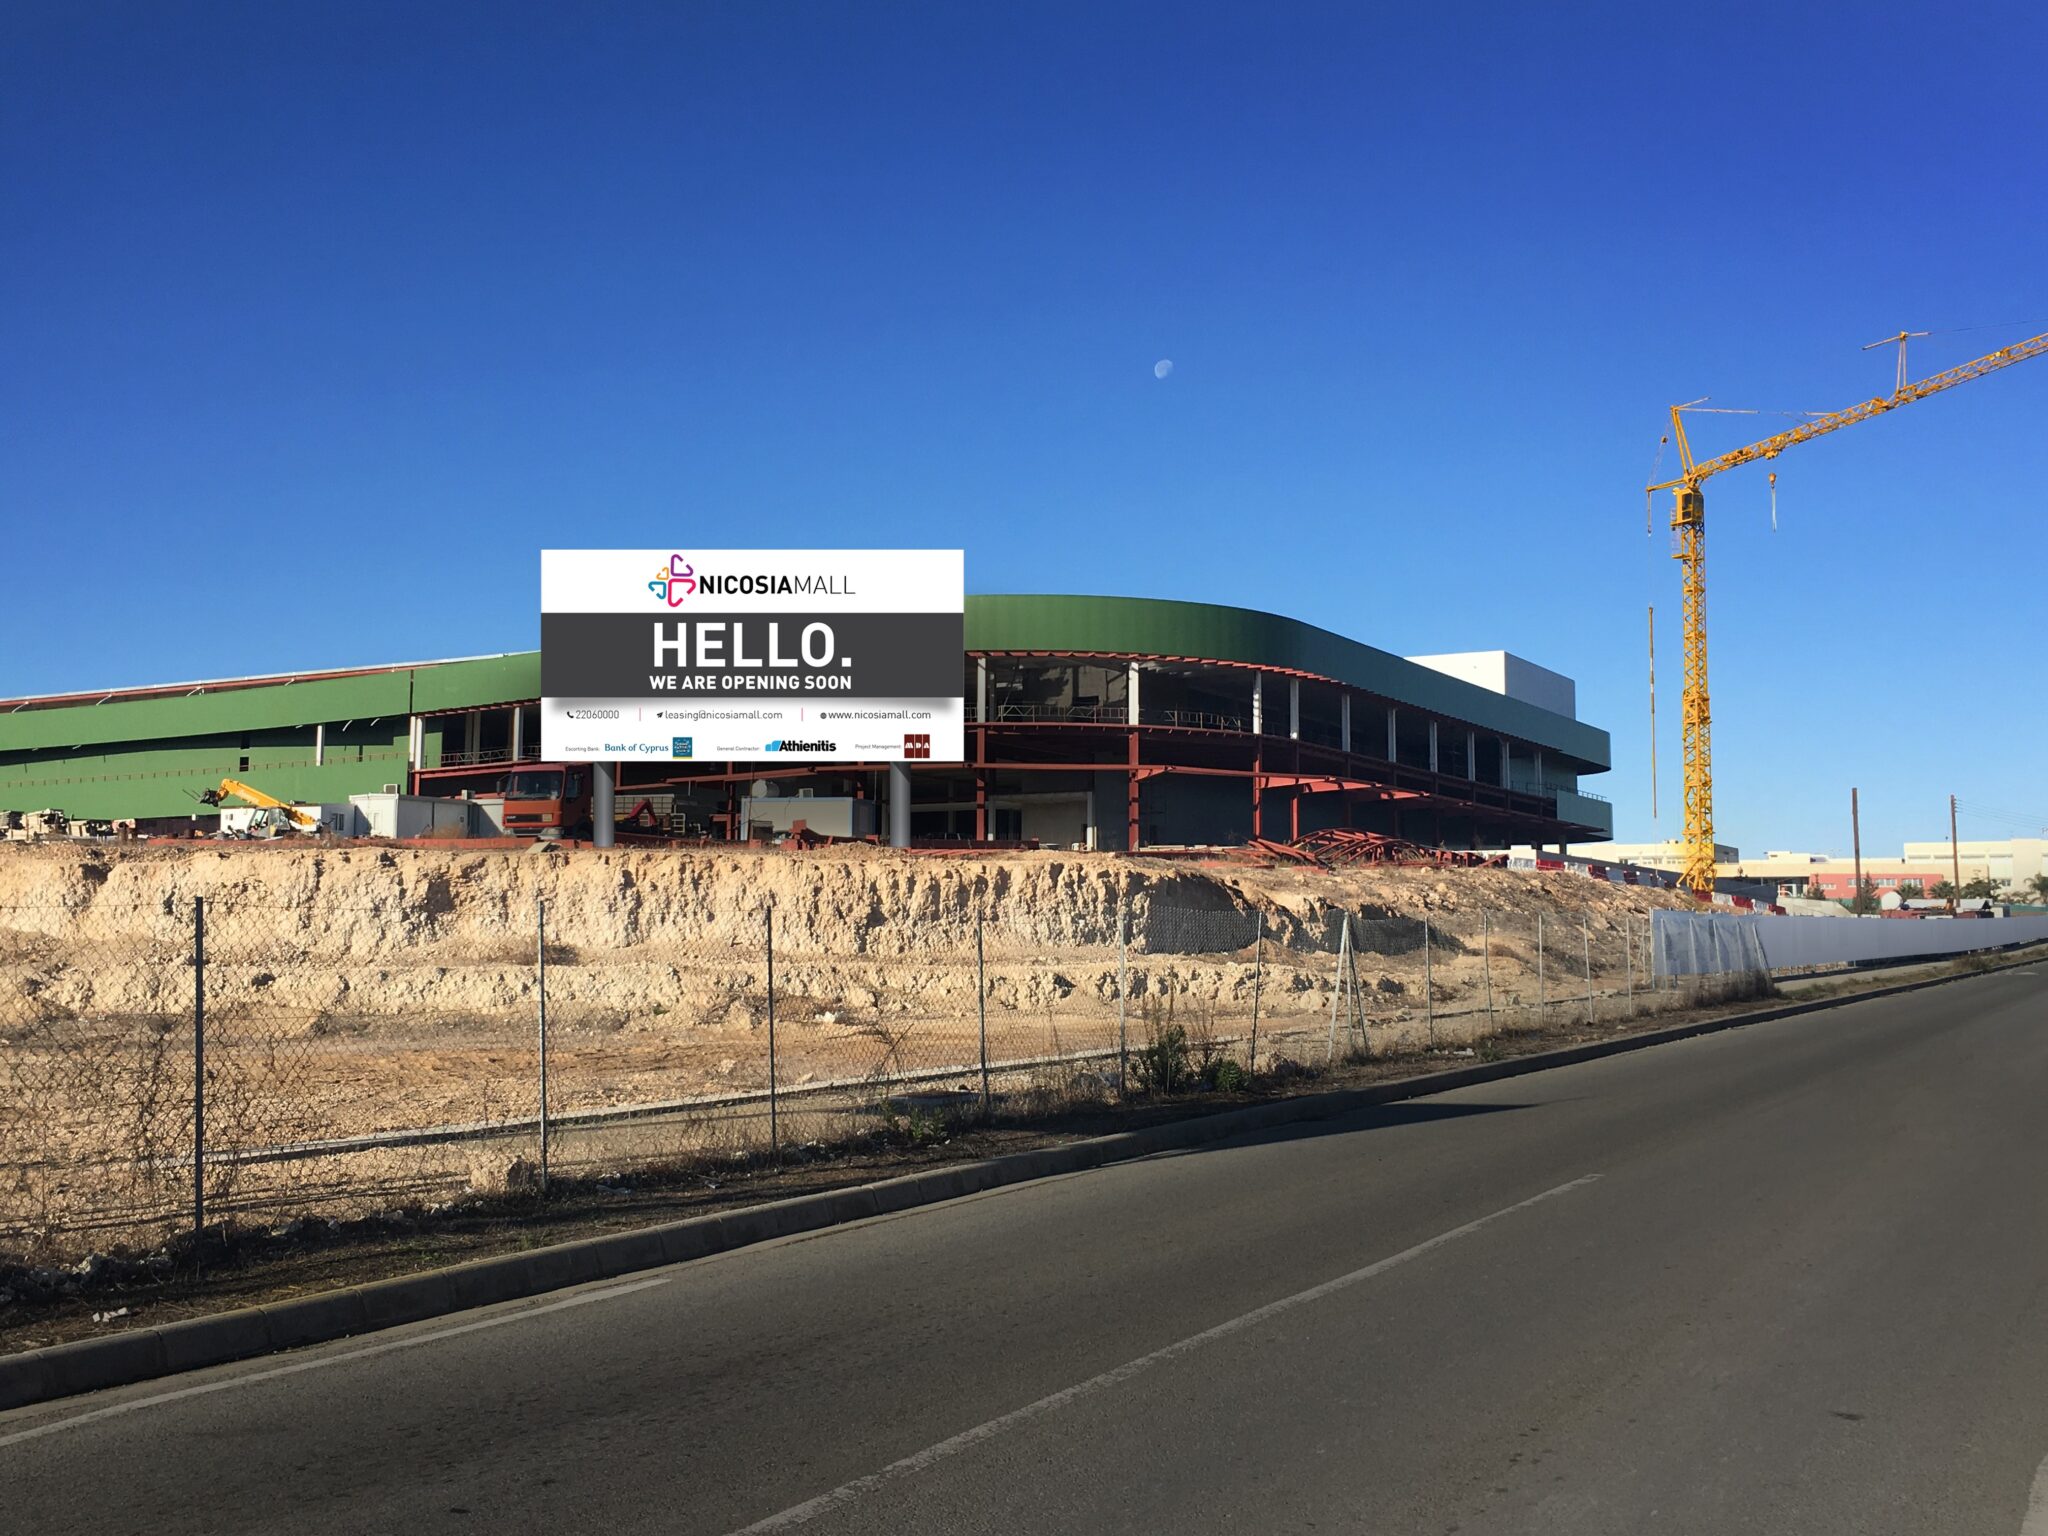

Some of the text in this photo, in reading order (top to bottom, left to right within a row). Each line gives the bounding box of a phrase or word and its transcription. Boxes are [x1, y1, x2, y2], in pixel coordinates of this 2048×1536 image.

[699, 575, 857, 595] NICOSIAMALL
[653, 622, 852, 667] HELLO.
[649, 675, 852, 690] WE ARE OPENING SOON
[575, 709, 620, 720] 22060000
[664, 709, 783, 722] leasing@nicosiamall.com
[828, 709, 932, 720] www.nicosiamall.com
[604, 743, 669, 754] Bank of Cyprus
[778, 740, 837, 752] Athienitis
